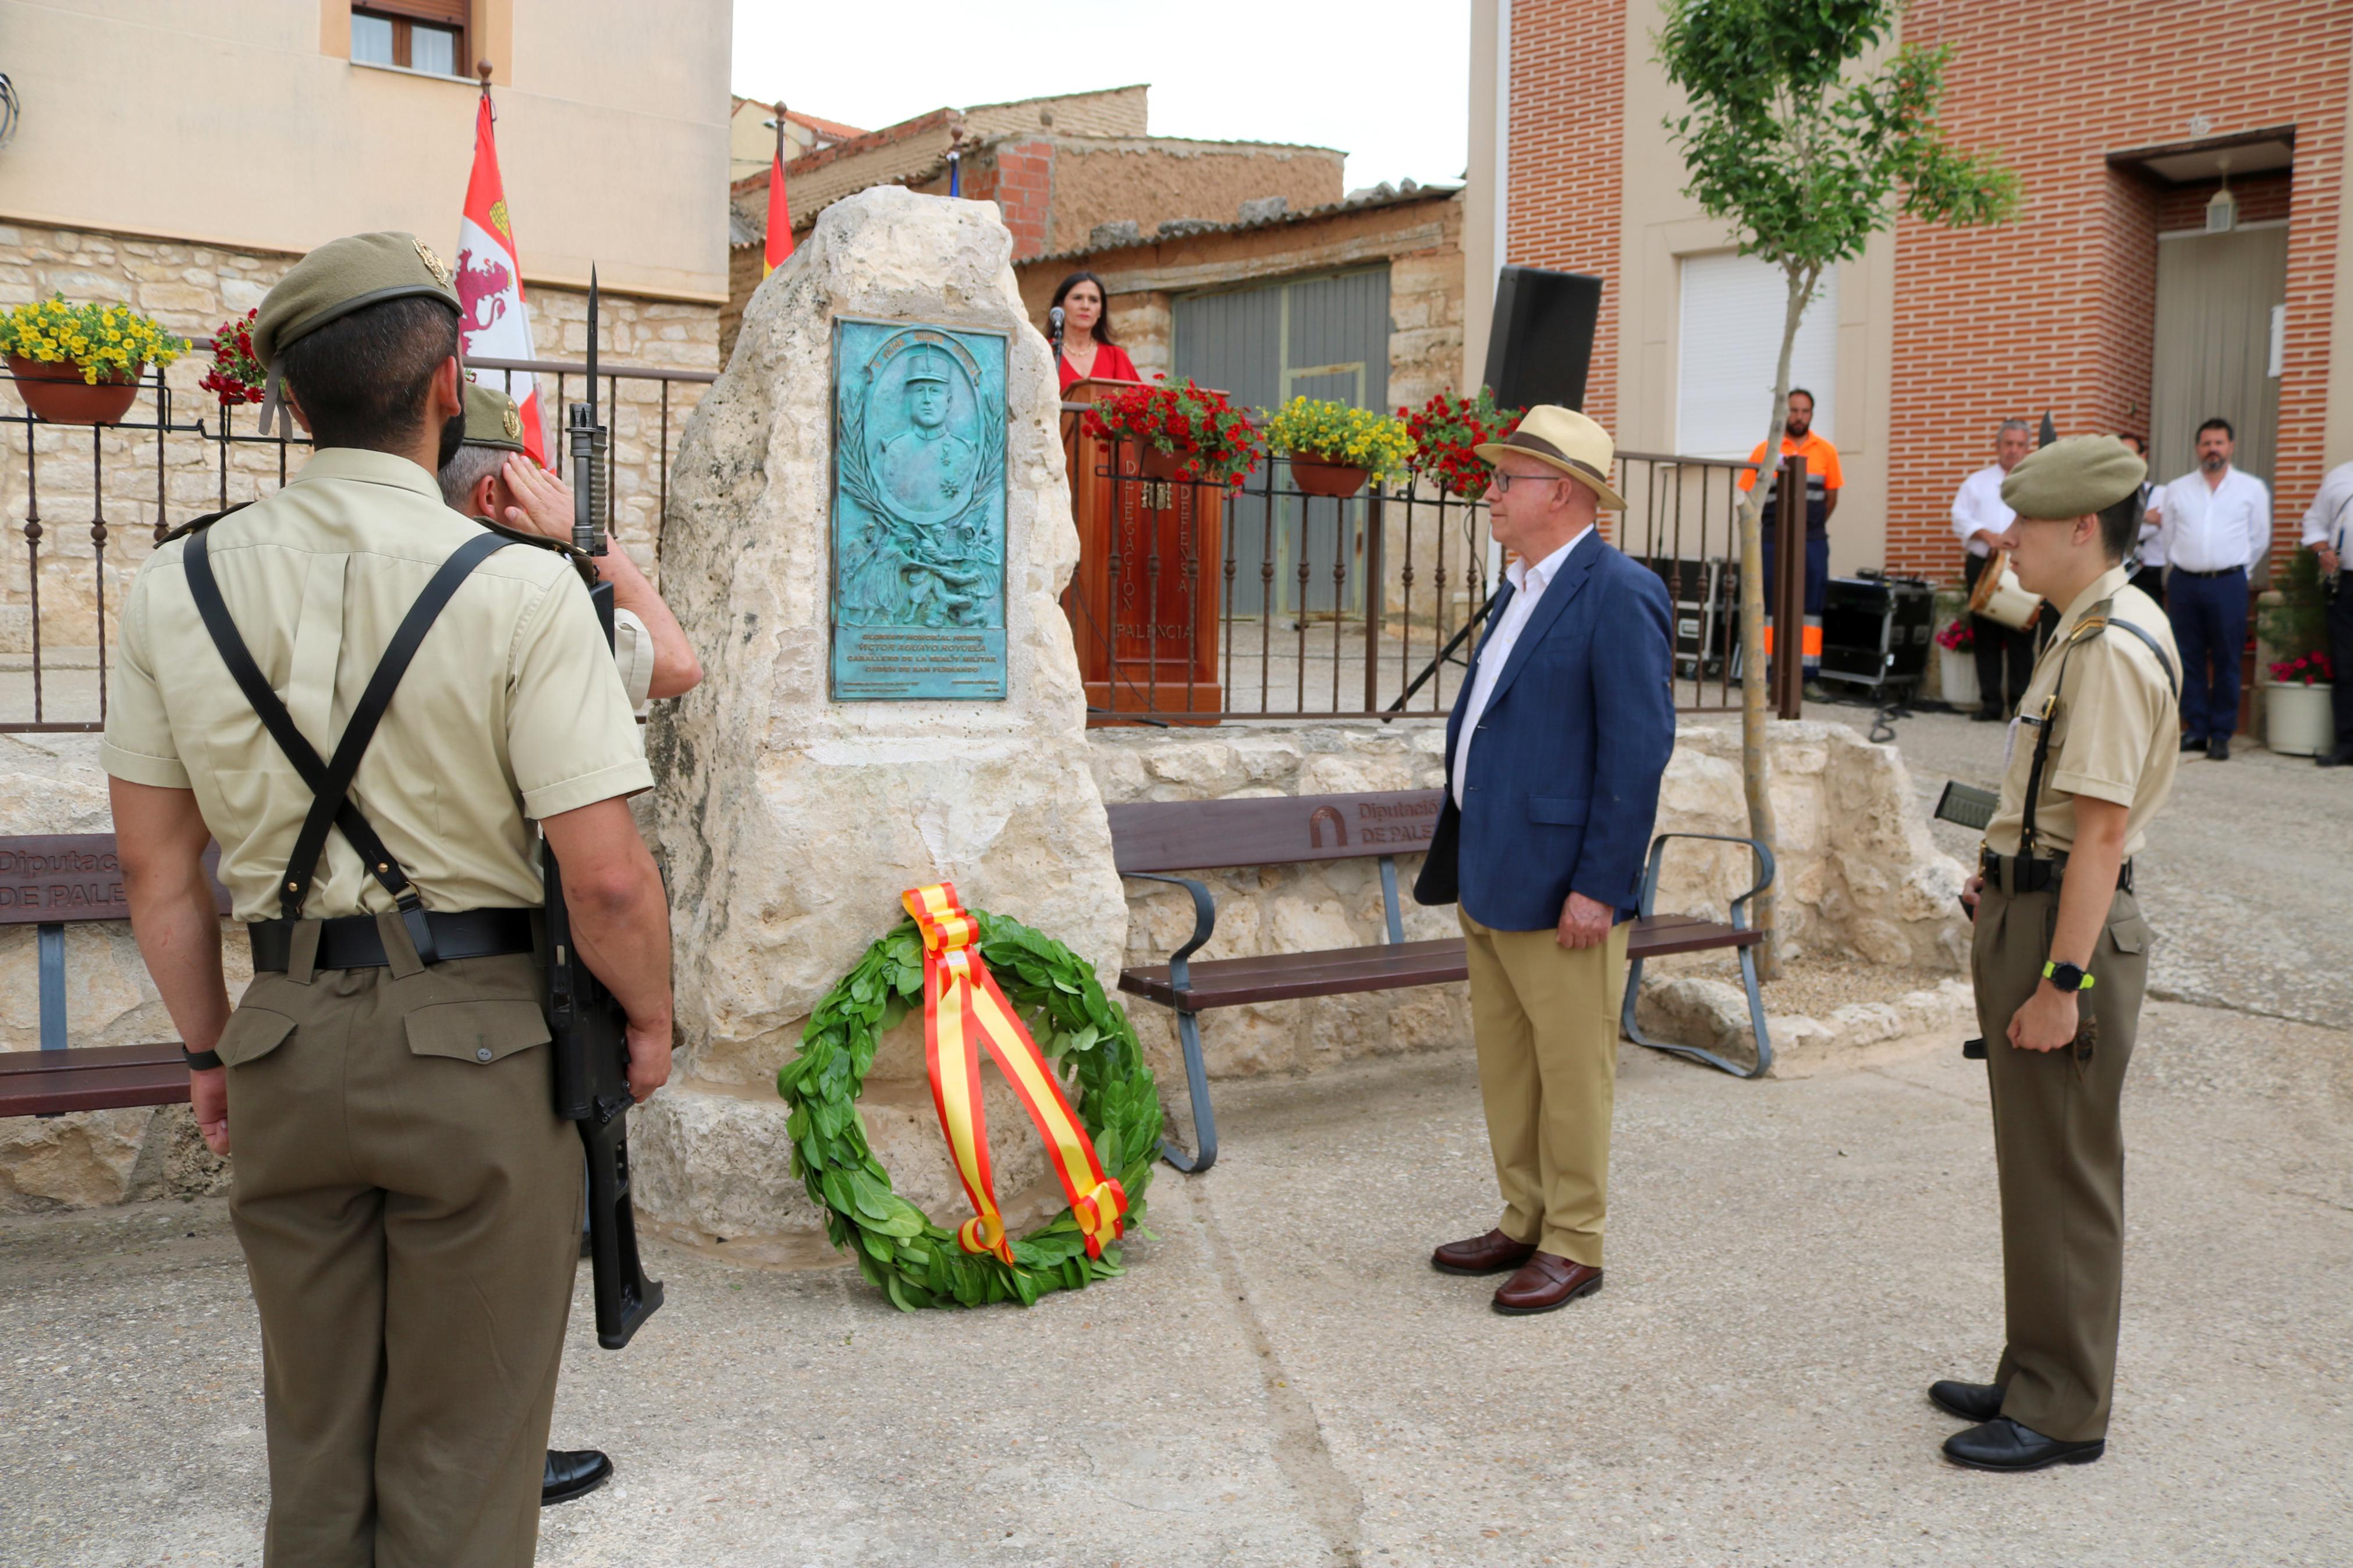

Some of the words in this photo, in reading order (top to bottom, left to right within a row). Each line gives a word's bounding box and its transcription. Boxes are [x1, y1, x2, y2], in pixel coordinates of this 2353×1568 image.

[1177, 486, 1191, 592] DEFENSA
[1358, 799, 1440, 822] Diputació
[1361, 827, 1387, 843] DE
[1390, 824, 1435, 842] PALE
[0, 851, 119, 877] Diputac
[0, 886, 39, 909] DE
[49, 883, 127, 908] PALE
